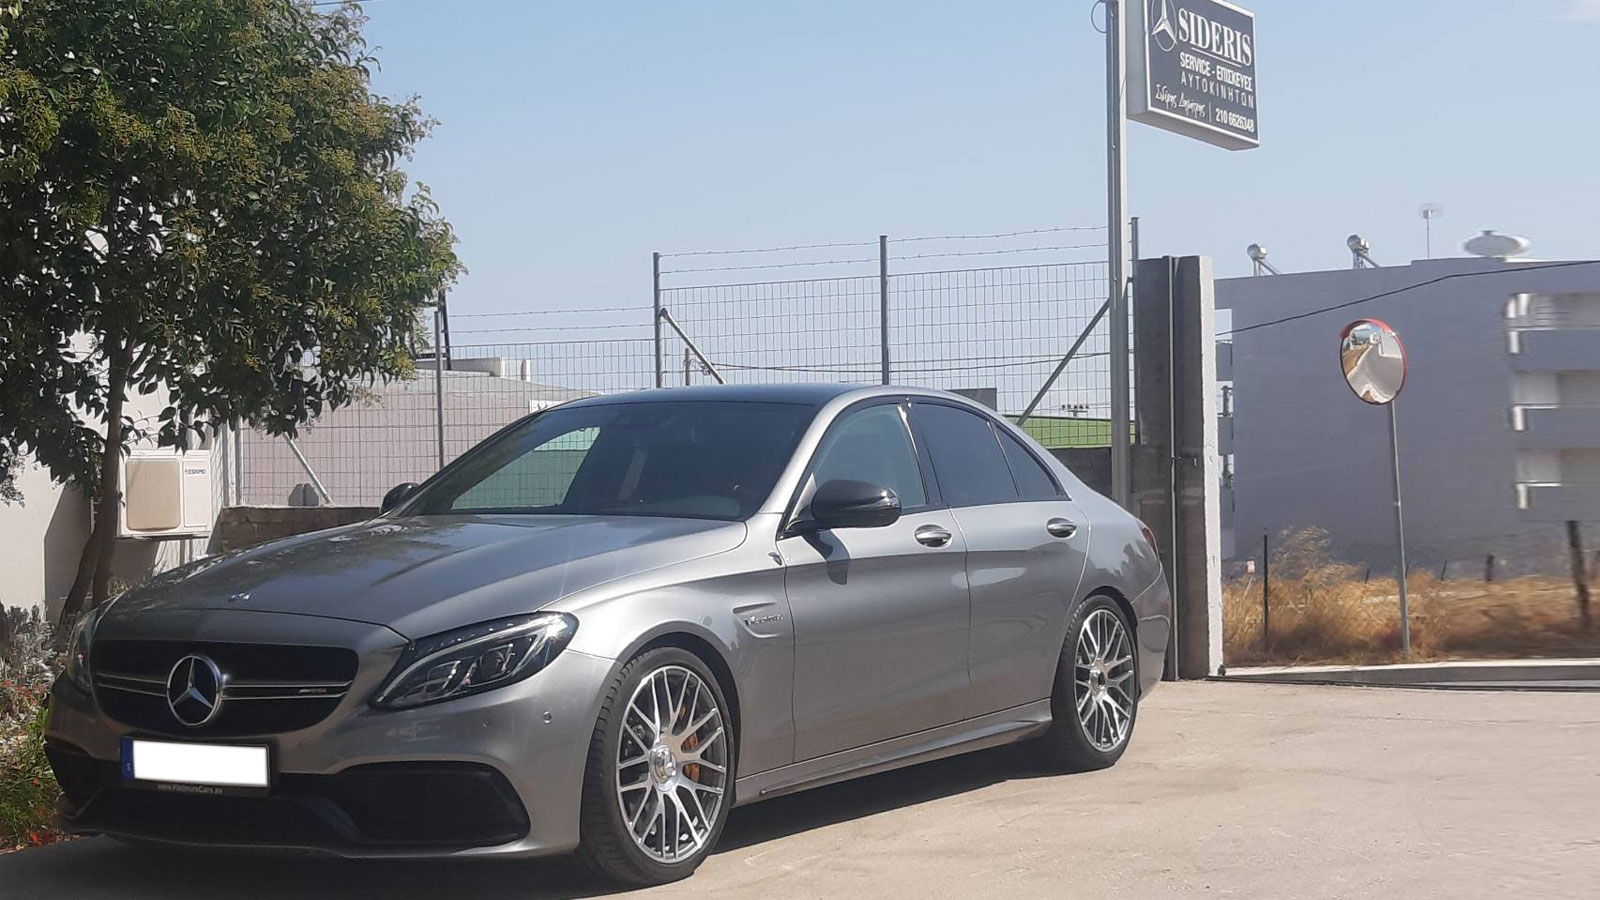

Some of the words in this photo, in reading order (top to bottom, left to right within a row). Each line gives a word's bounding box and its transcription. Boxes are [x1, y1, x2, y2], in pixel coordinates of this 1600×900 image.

[1178, 8, 1252, 65] SIDERIS
[1180, 52, 1210, 76] SERVICE
[1181, 71, 1254, 108] ΑΥΤΟΚΙΝΗΤΩΝ
[1215, 108, 1228, 124] 210
